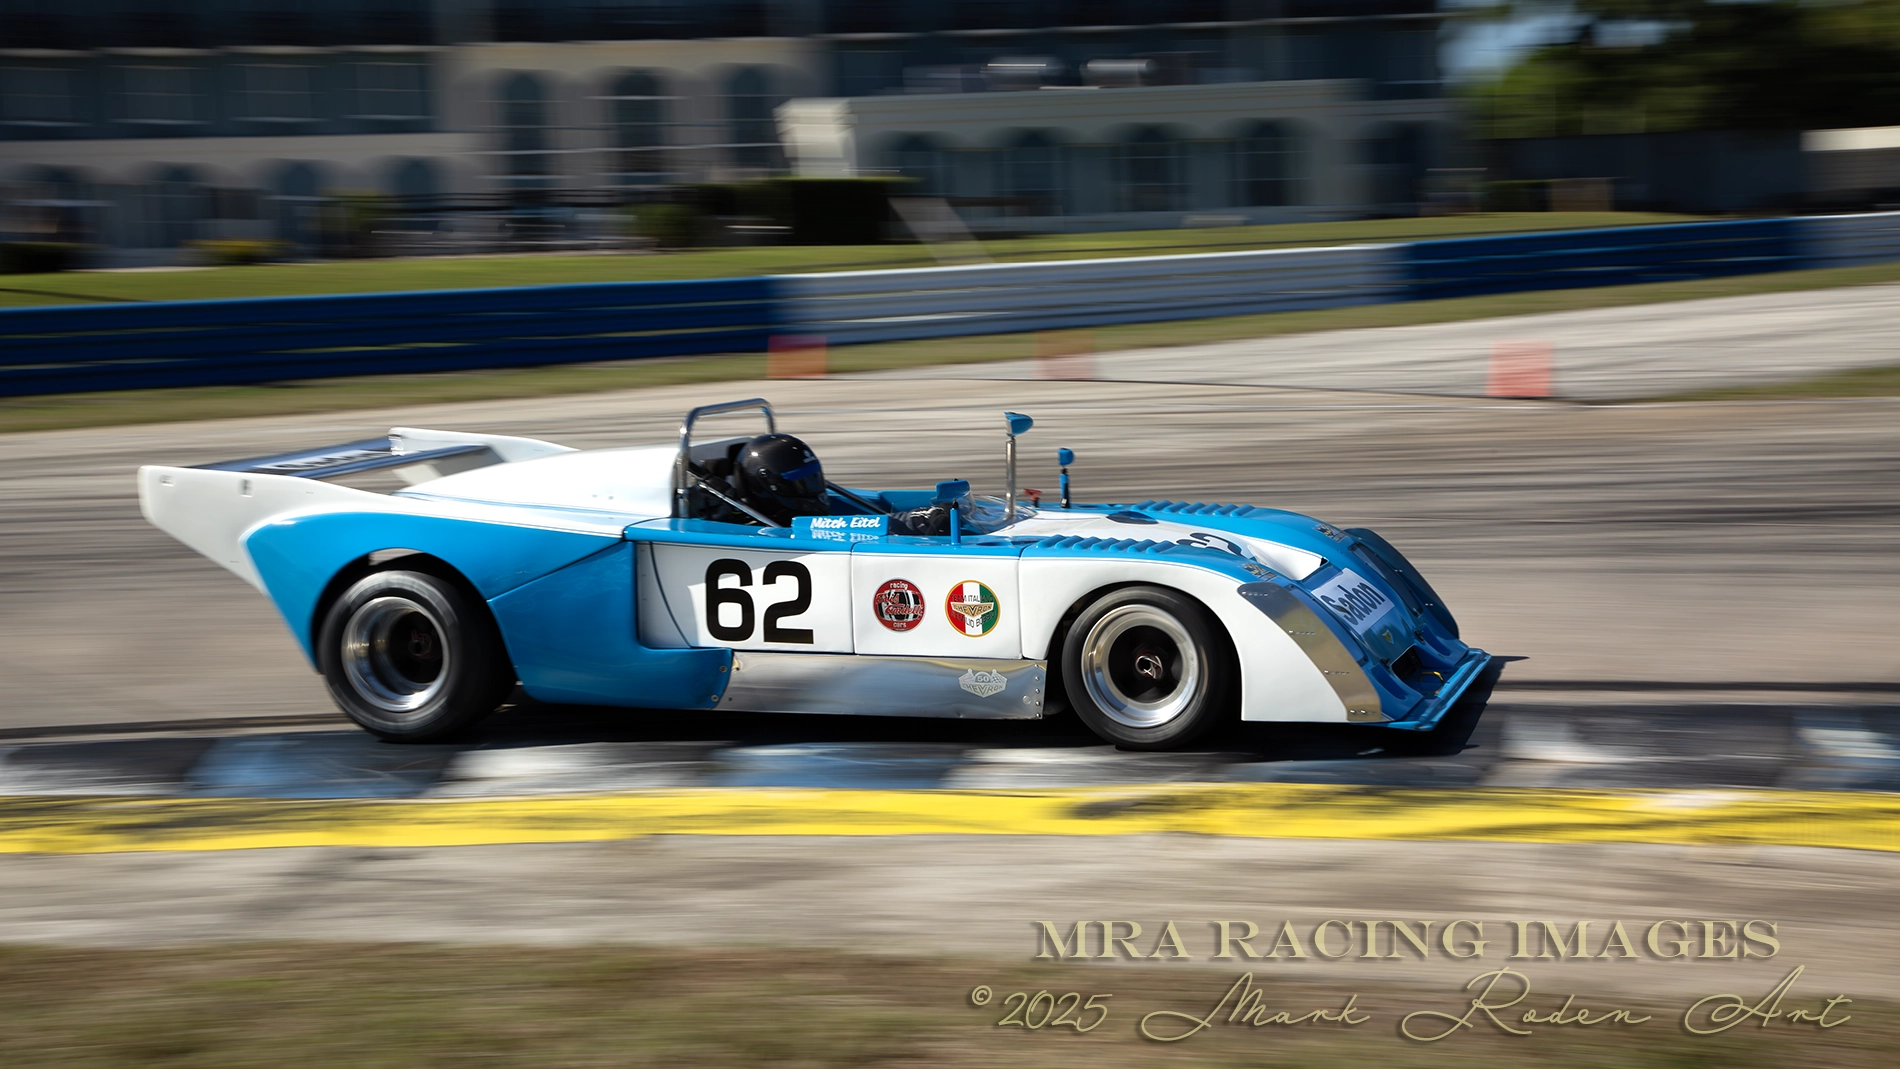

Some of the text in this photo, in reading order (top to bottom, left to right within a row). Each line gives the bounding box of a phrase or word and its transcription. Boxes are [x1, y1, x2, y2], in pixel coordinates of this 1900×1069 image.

[810, 517, 881, 530] Mitch Eitel
[890, 581, 908, 591] racing
[705, 558, 814, 645] 62
[1320, 582, 1386, 626] Sadon
[953, 603, 992, 618] CHEVRON
[977, 675, 989, 683] 50
[963, 683, 1003, 697] CHEVRON
